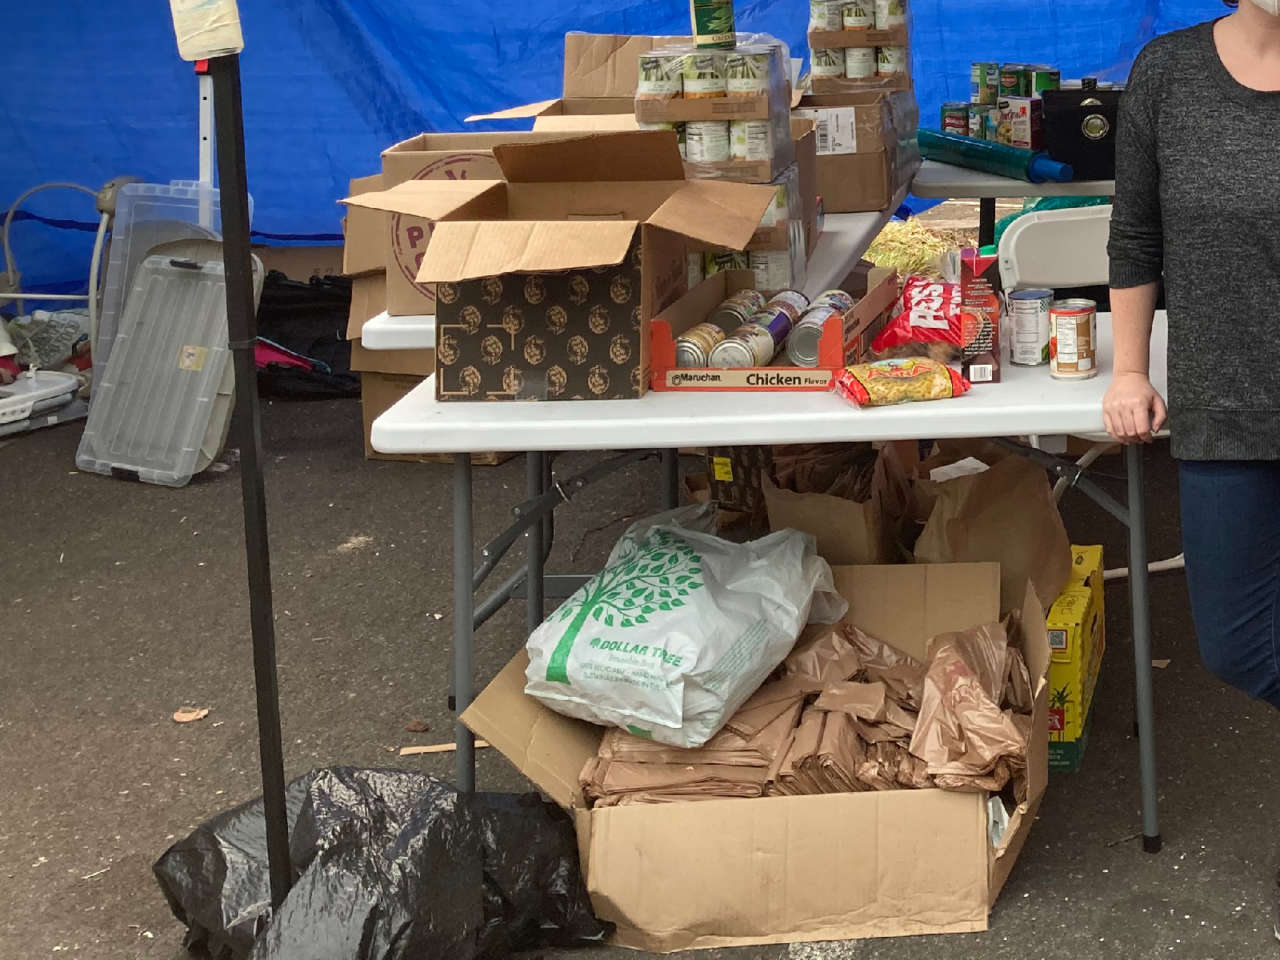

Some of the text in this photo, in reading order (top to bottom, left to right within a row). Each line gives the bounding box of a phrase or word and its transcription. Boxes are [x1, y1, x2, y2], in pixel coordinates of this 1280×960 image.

[746, 372, 801, 386] Chicken
[600, 640, 684, 668] DOLLAR TREE
